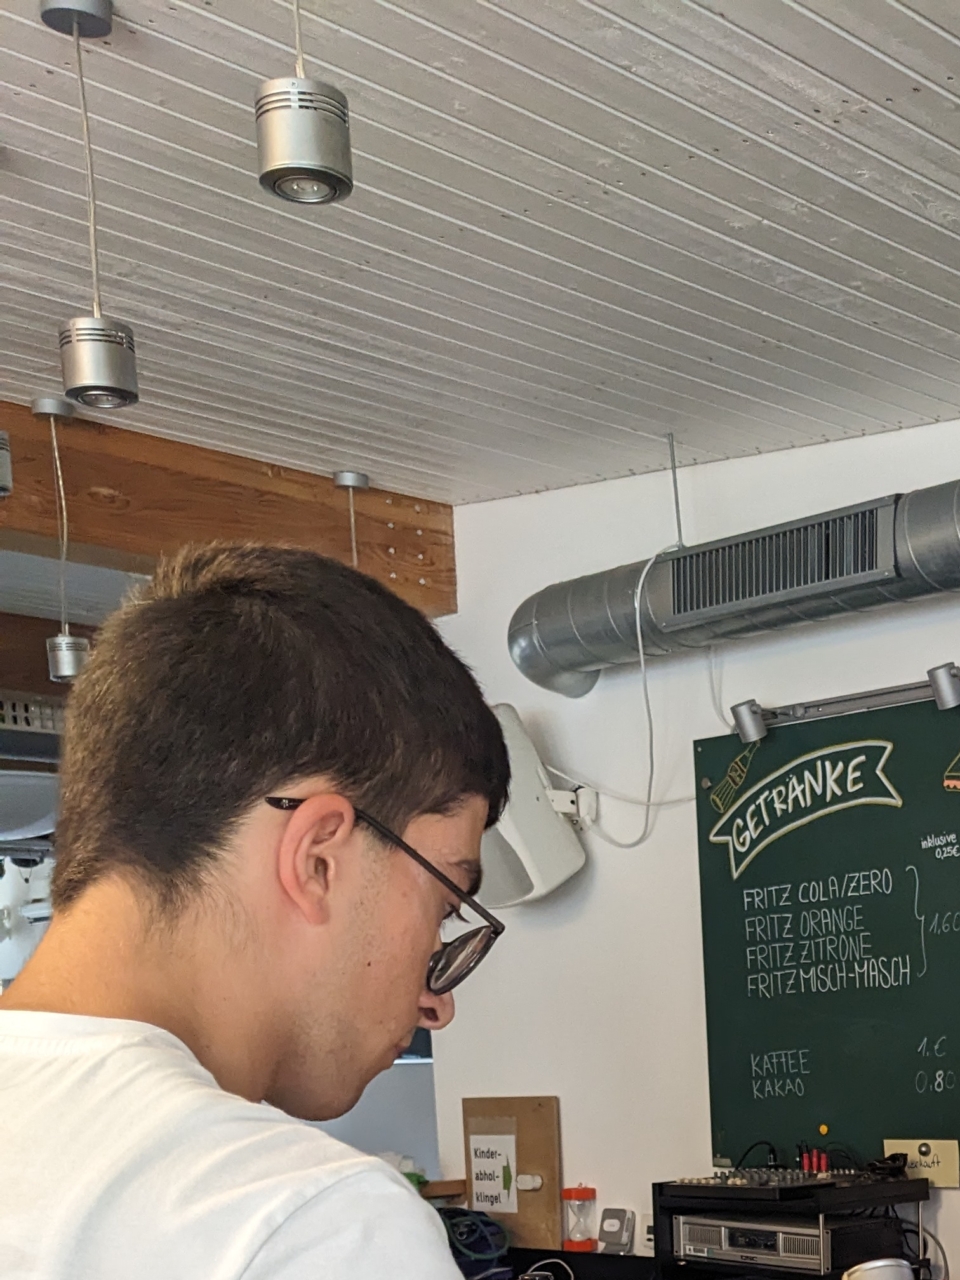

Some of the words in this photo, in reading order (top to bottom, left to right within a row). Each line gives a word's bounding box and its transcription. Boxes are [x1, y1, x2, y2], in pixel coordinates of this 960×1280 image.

[732, 755, 867, 852] GETRÄNKE
[921, 831, 958, 849] inklusive
[935, 845, 960, 860] 0,25€
[743, 884, 792, 911] FRITZ
[798, 868, 893, 903] COLA/ZERO
[745, 913, 794, 941] FRITZ
[799, 905, 865, 937] ORANGE
[746, 943, 796, 970] FRITZ
[799, 932, 872, 964] ZITRONE
[747, 971, 797, 999] FRITZ
[800, 955, 911, 993] MISCH-MASCH
[750, 1050, 811, 1077] KAFFEE
[752, 1078, 805, 1099] KAKAO
[474, 1147, 502, 1159] Kinder-
[475, 1170, 500, 1182] abhol-
[475, 1192, 502, 1206] klingel
